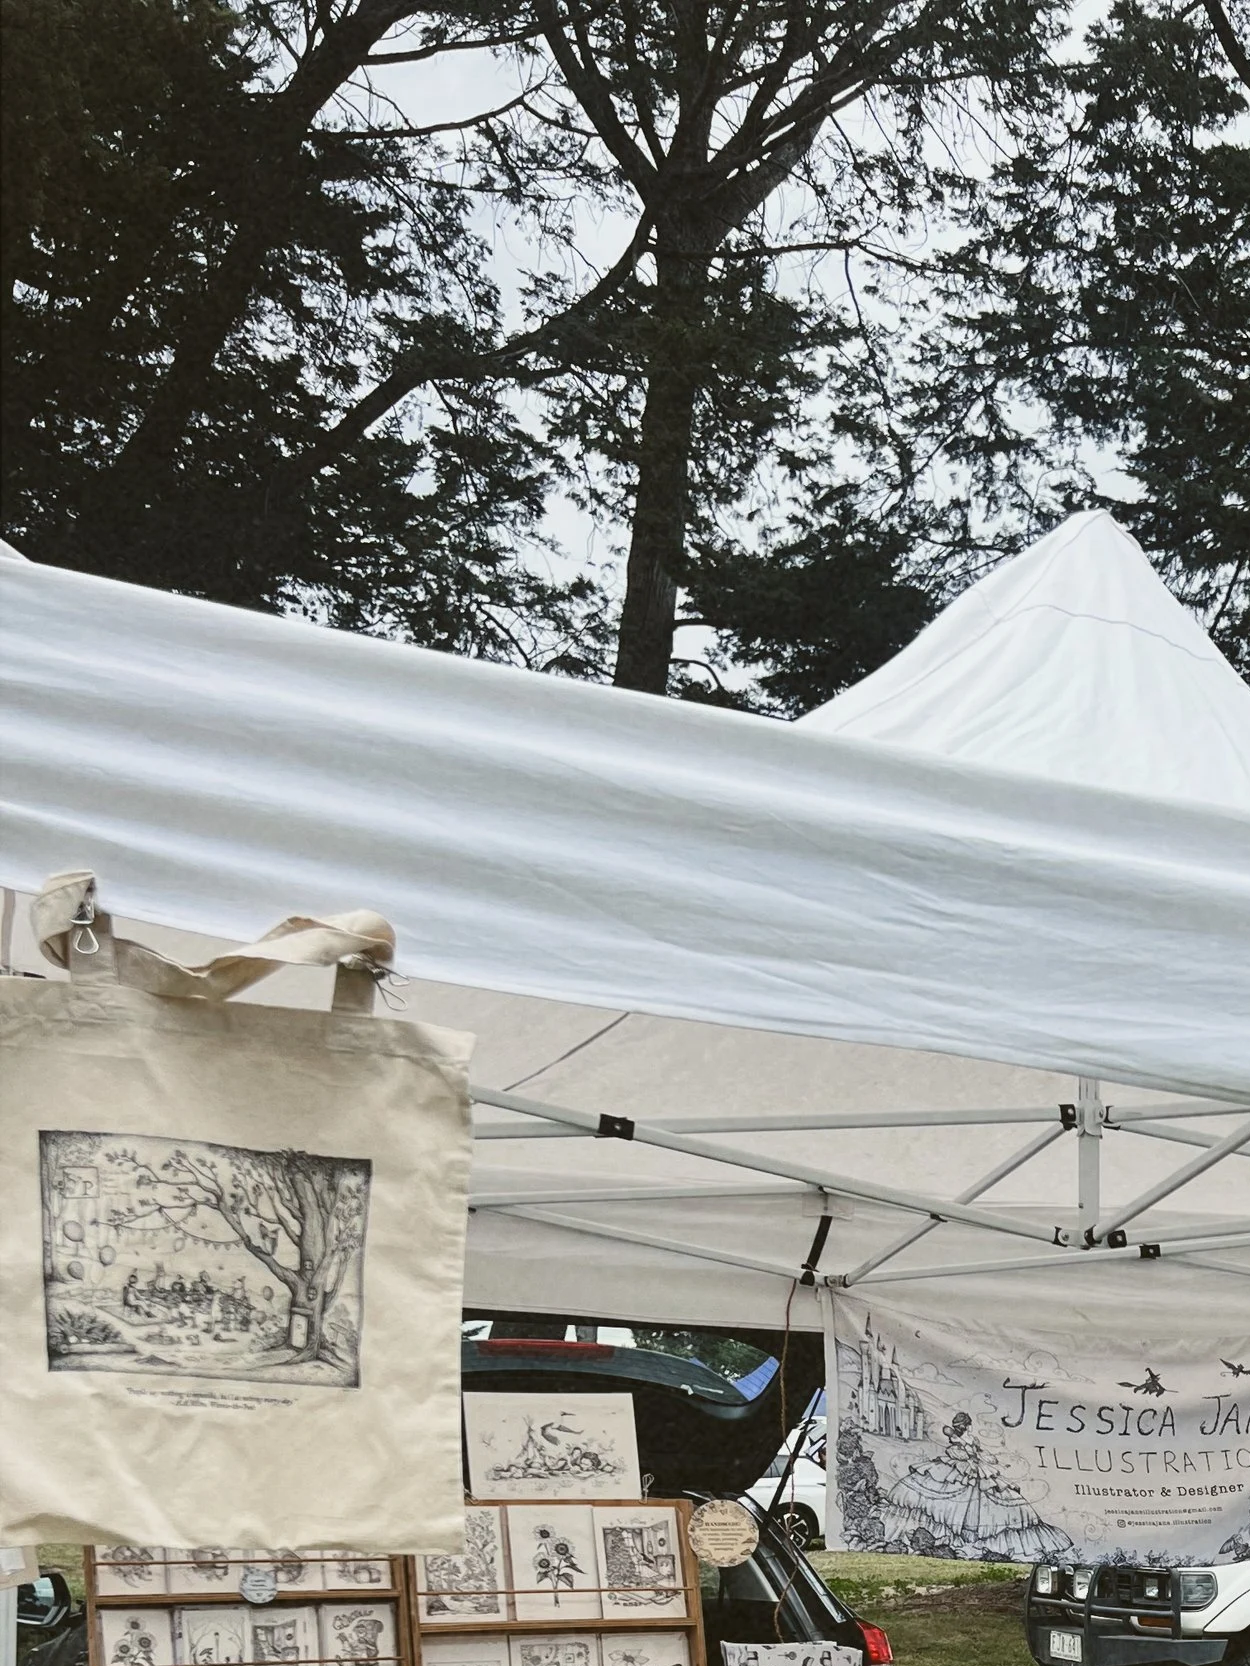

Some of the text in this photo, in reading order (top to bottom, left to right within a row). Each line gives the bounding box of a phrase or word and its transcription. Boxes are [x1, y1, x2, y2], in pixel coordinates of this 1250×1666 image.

[1001, 1377, 1176, 1437] JESSICA
[1074, 1483, 1245, 1498] Illustrator & Designer
